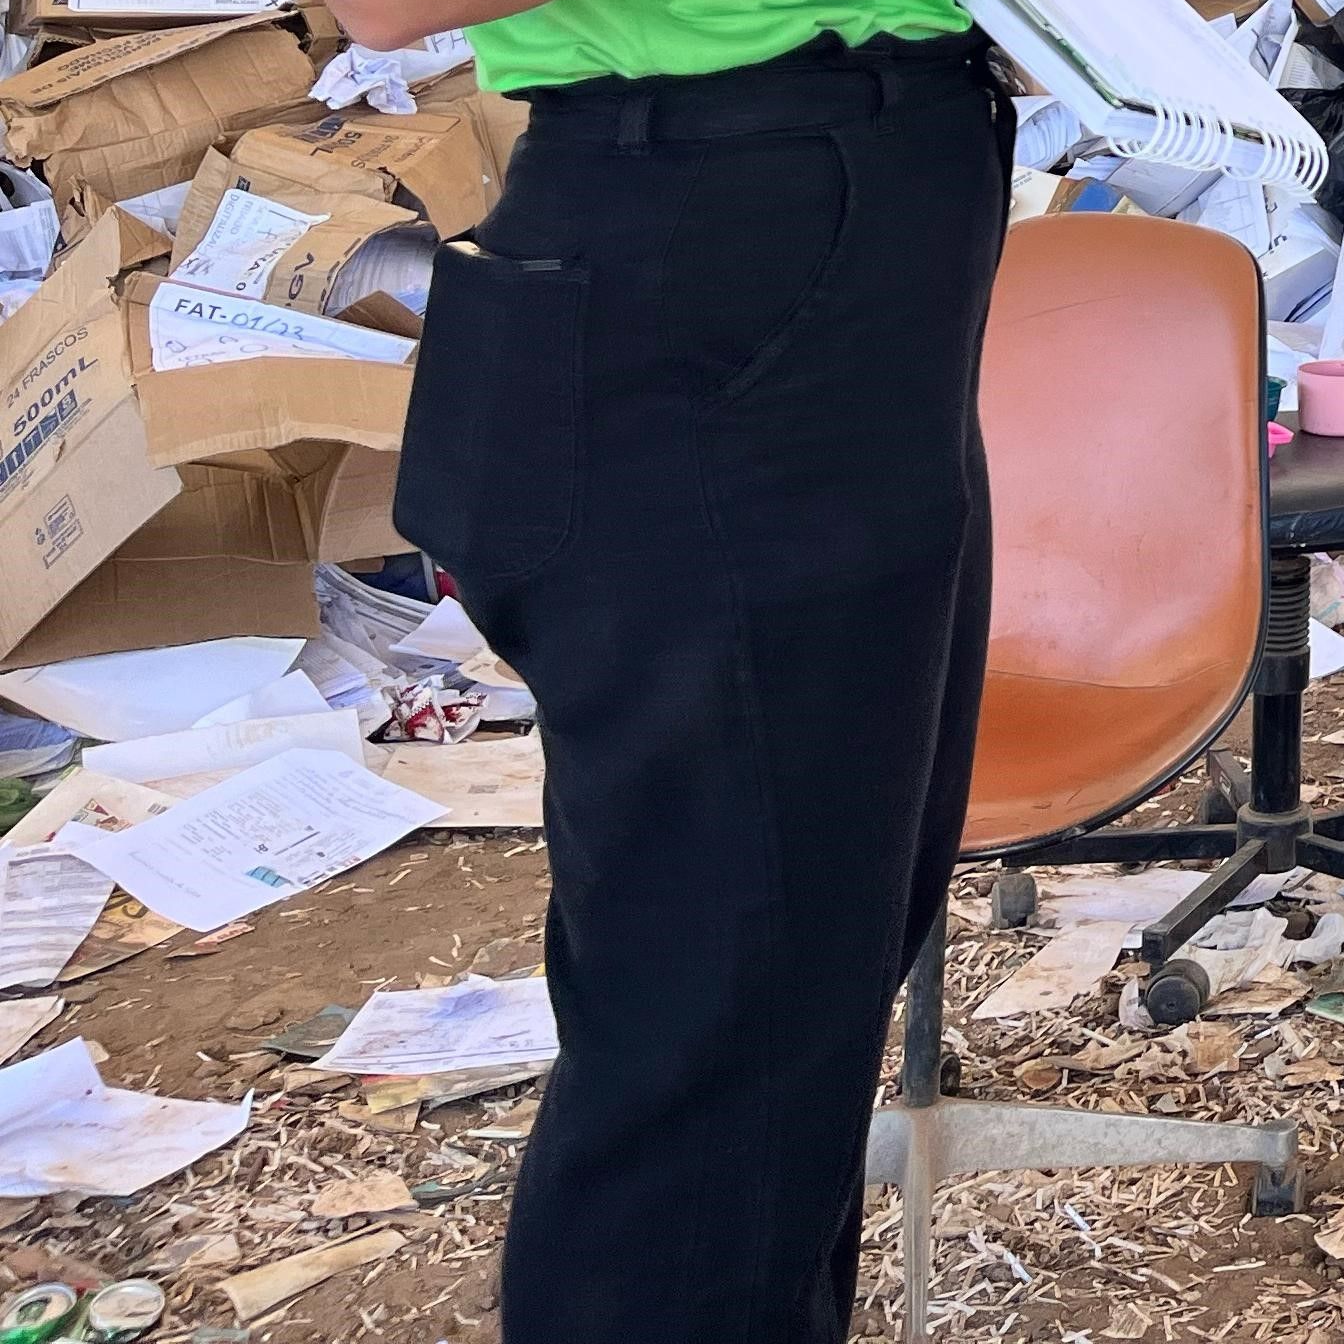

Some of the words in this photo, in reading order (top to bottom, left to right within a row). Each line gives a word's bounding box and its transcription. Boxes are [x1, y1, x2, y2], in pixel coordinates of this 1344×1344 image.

[7, 388, 21, 409] 24
[22, 327, 89, 391] FRASCOS
[13, 356, 99, 437] 500mL
